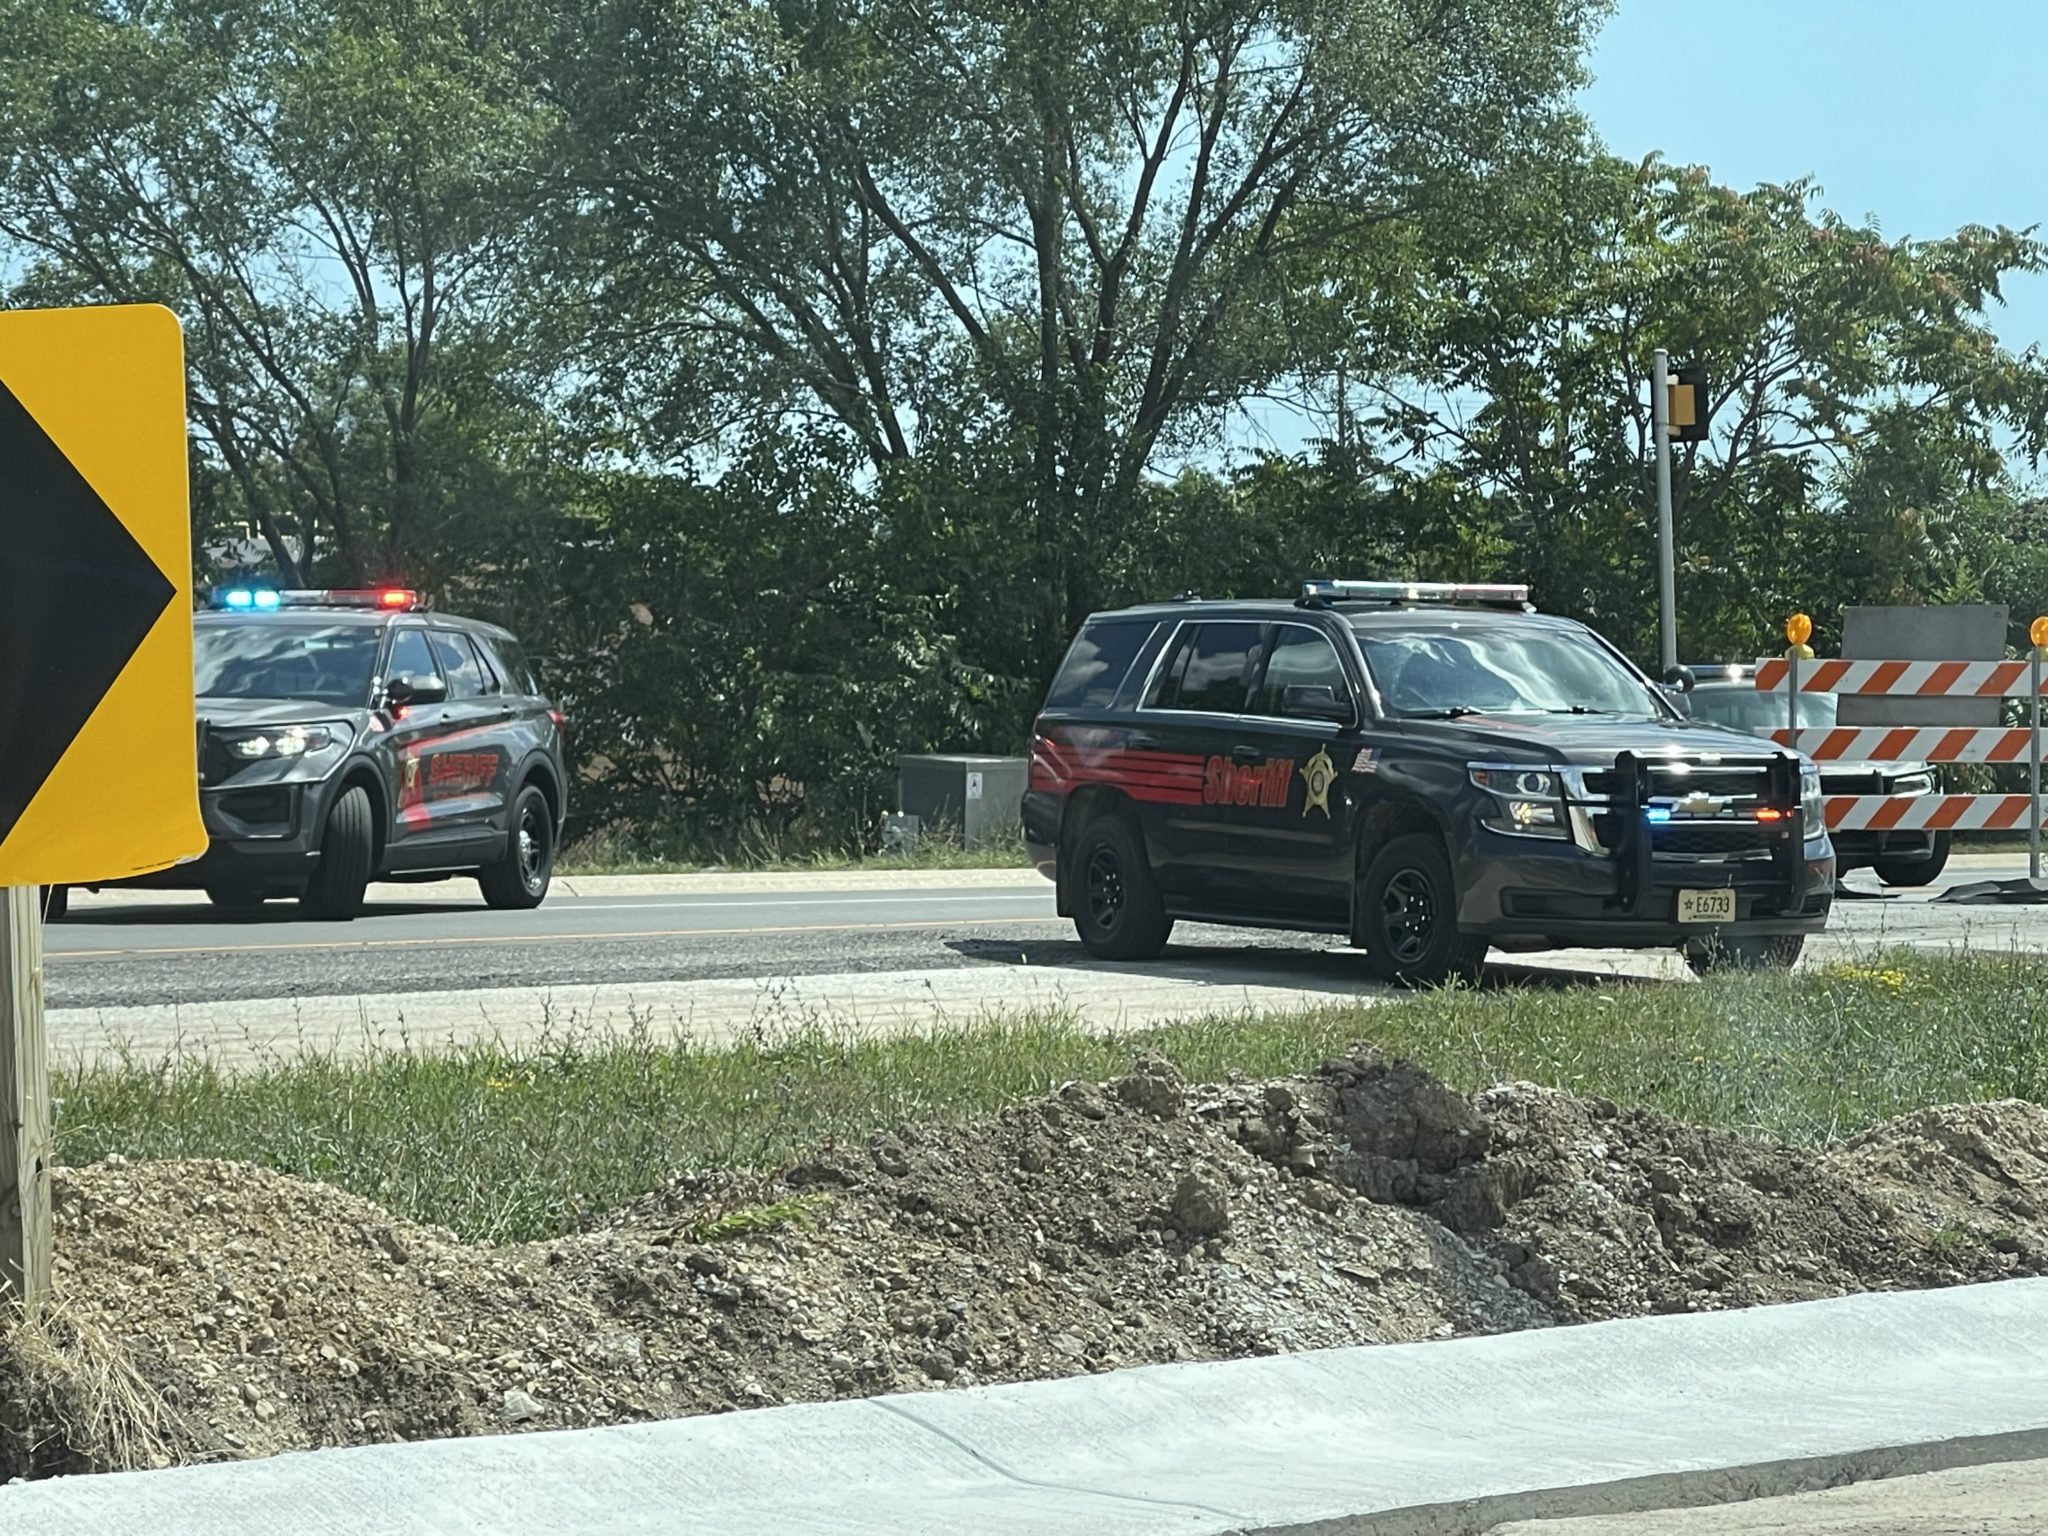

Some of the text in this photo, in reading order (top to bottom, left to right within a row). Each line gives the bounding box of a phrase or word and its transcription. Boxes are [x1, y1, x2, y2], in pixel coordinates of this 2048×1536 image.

[428, 753, 499, 787] SHERIFF
[1203, 755, 1294, 807] Sheriff
[1696, 896, 1730, 913] E6733
